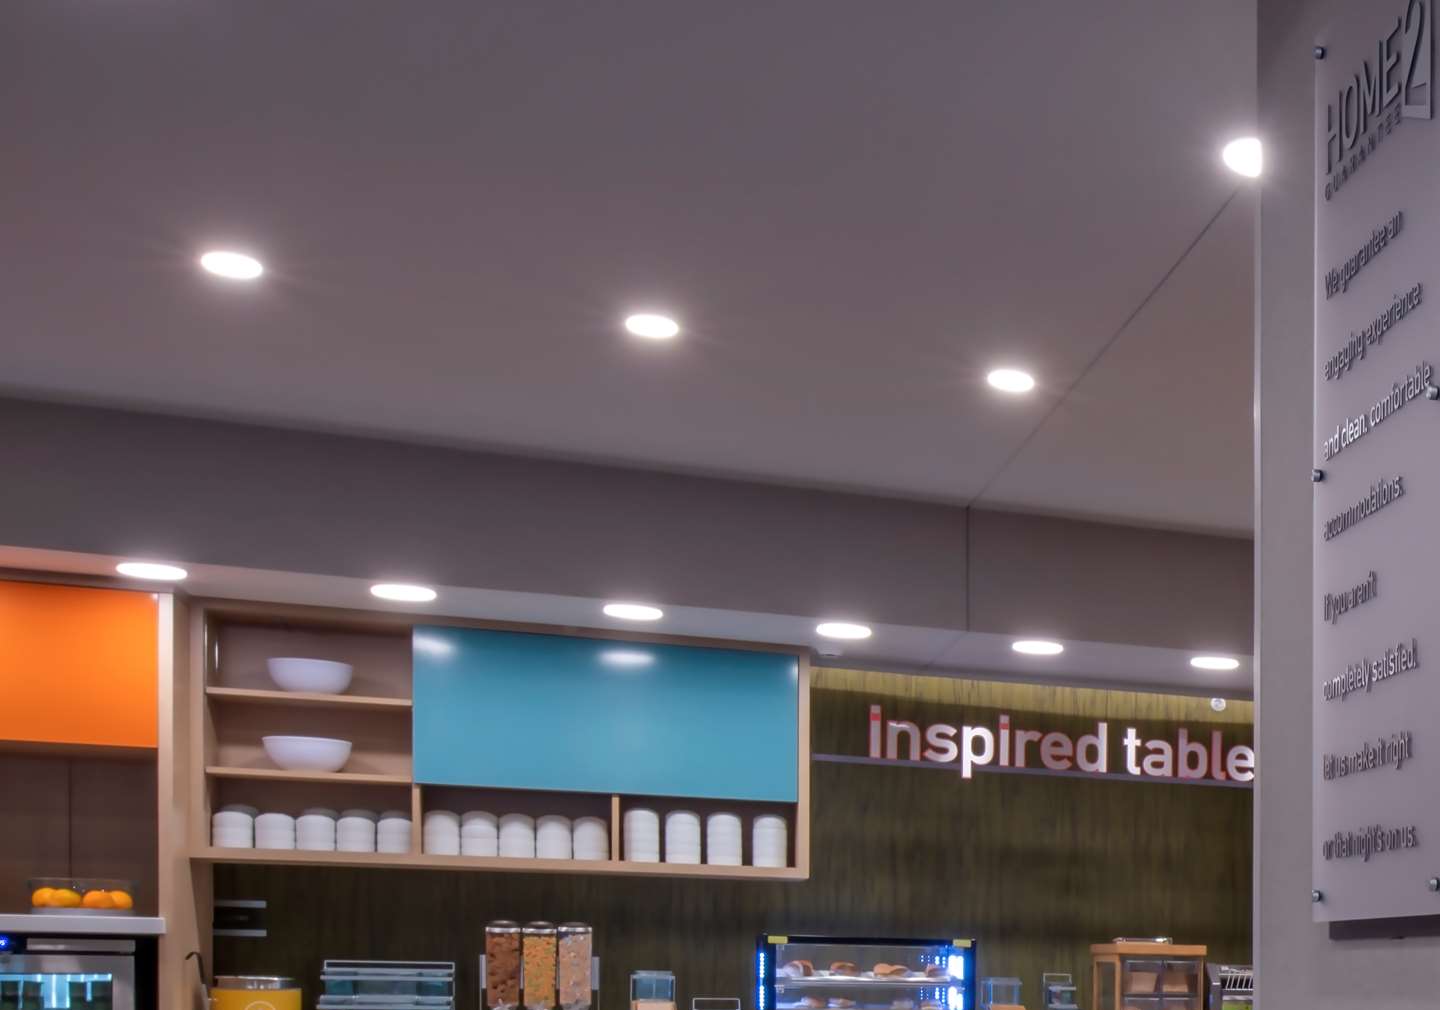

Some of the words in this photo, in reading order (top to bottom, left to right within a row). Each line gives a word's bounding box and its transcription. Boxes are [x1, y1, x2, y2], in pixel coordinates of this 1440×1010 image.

[1340, 226, 1387, 294] guarantee
[1324, 330, 1366, 381] engaging
[1366, 282, 1423, 345] experience
[1323, 424, 1340, 460] and
[1369, 362, 1432, 427] comfortable
[1322, 657, 1371, 702] completely
[869, 704, 1108, 779] inspired
[1123, 727, 1255, 782] table
[1349, 741, 1376, 774] make
[1385, 731, 1412, 771] right
